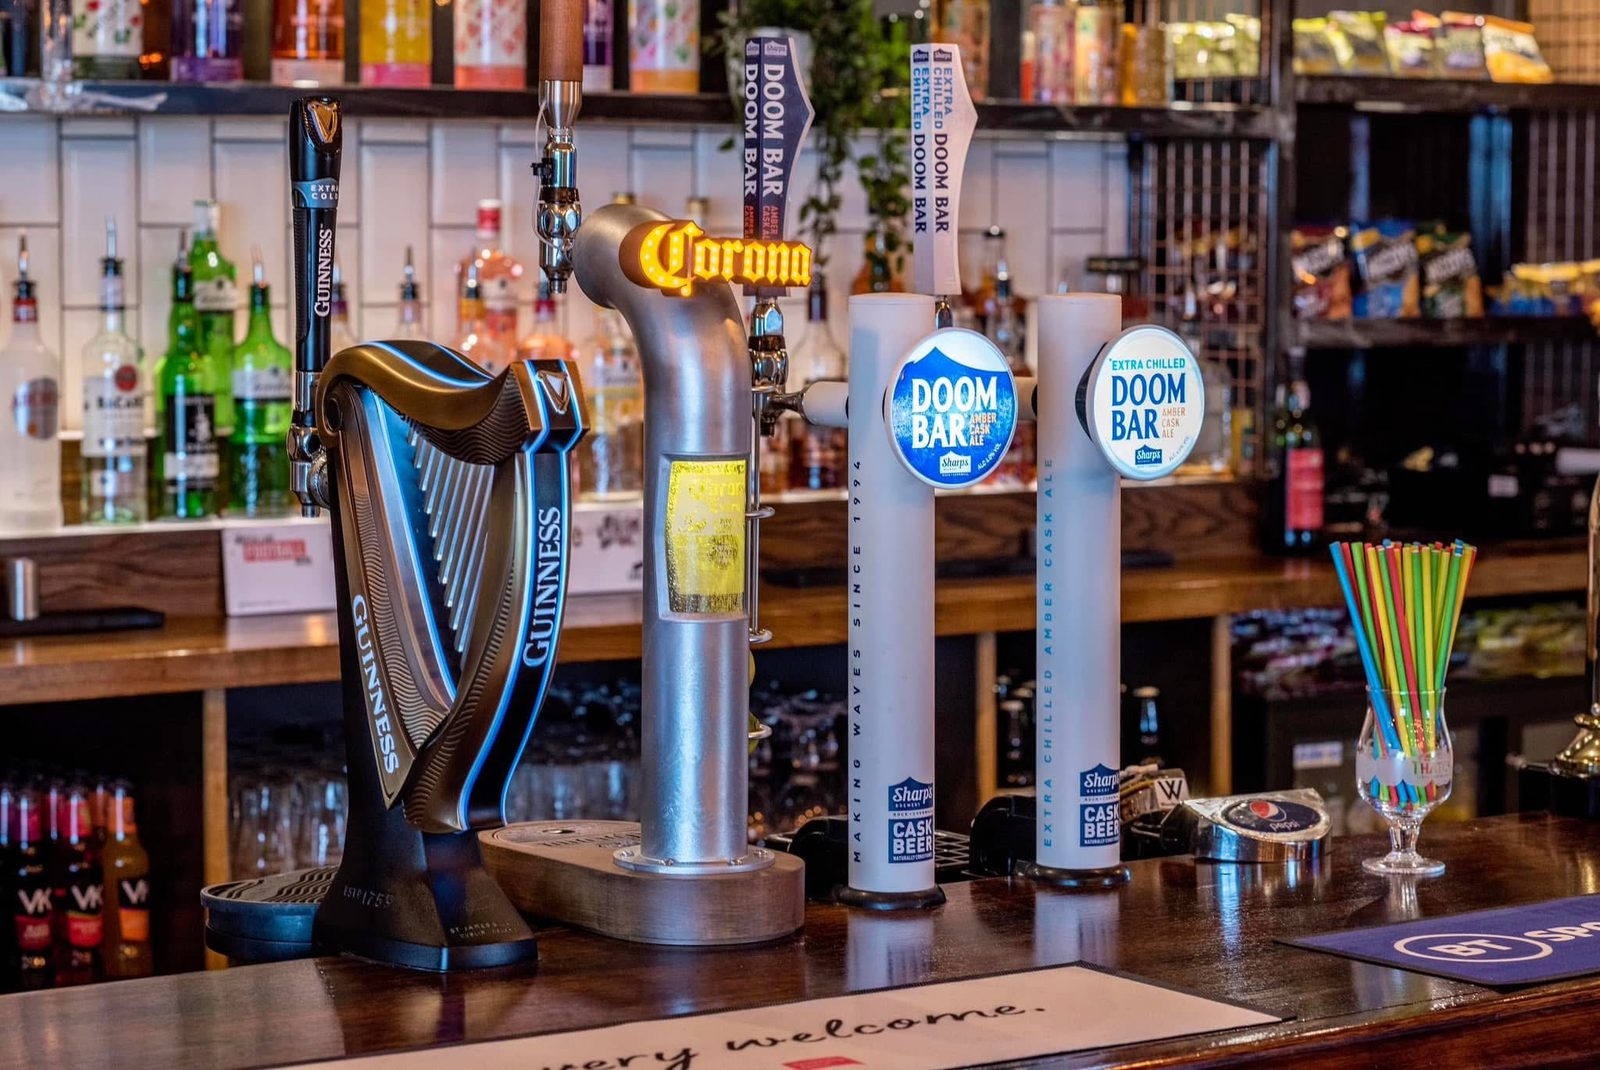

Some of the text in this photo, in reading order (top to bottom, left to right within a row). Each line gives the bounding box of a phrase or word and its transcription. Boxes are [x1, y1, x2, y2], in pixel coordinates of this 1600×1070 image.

[745, 64, 758, 138] DOOM
[913, 68, 921, 129] CHILLED
[921, 67, 930, 115] EXTRA
[933, 67, 943, 129] CHILLED
[943, 67, 952, 115] EXTRA
[763, 64, 784, 197] DOOM BAR
[744, 148, 757, 197] BAR
[914, 134, 927, 234] DOOM BAR
[934, 133, 949, 234] DOOM BAR
[763, 205, 771, 228] CASK
[770, 206, 778, 235] AMBER
[313, 228, 333, 317] GUINNESS
[639, 221, 813, 297] Corona
[1111, 358, 1186, 371] EXTRA CHILLED
[911, 375, 998, 413] DOOM
[1111, 373, 1186, 407] DOOM
[969, 423, 990, 435] CASK
[970, 412, 997, 424] AMBER
[1111, 408, 1160, 441] BAR
[1161, 407, 1186, 417] AMBER
[1161, 418, 1180, 428] CASK
[911, 412, 968, 449] BAR
[969, 434, 985, 446] ALE
[1161, 428, 1174, 439] ALE
[1044, 513, 1052, 567] CASK
[522, 506, 561, 667] GUINNESS
[1044, 583, 1052, 655] AMBER
[853, 461, 861, 863] MAKING WAVES SINCE 1994
[352, 594, 399, 775] GUINNESS
[1044, 670, 1052, 763] CHILLED
[892, 786, 933, 805] Sharp's
[1044, 778, 1052, 847] EXTRA
[1084, 804, 1119, 822] CASK
[893, 818, 932, 838] CASK
[1084, 820, 1119, 839] BEER
[1269, 819, 1301, 832] pepsi
[893, 835, 932, 855] BEER
[18, 886, 53, 915] VK
[71, 884, 104, 910] VK
[1427, 939, 1513, 957] BT
